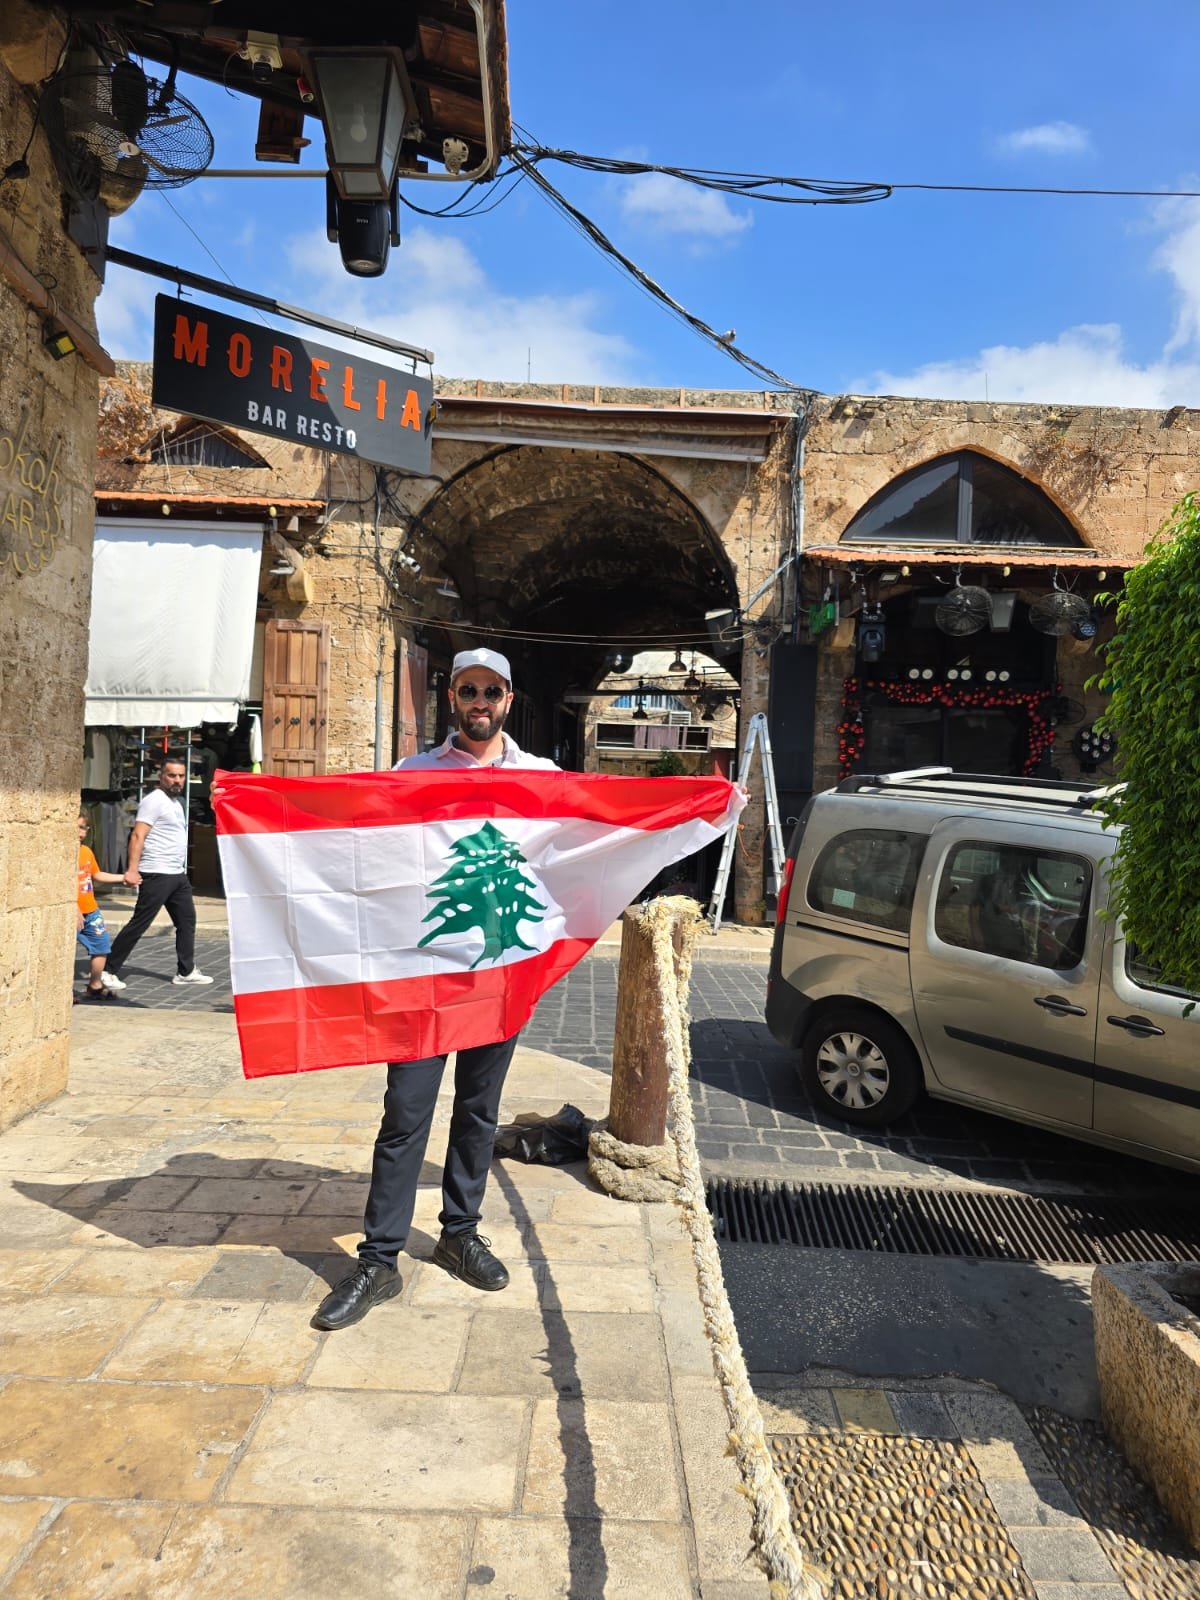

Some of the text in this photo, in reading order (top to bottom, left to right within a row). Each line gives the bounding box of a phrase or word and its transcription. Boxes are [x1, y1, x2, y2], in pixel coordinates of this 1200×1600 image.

[172, 314, 422, 432] MORELIA
[0, 414, 64, 505] okah
[247, 400, 358, 449] BAR RESTO
[1, 492, 34, 541] AR
